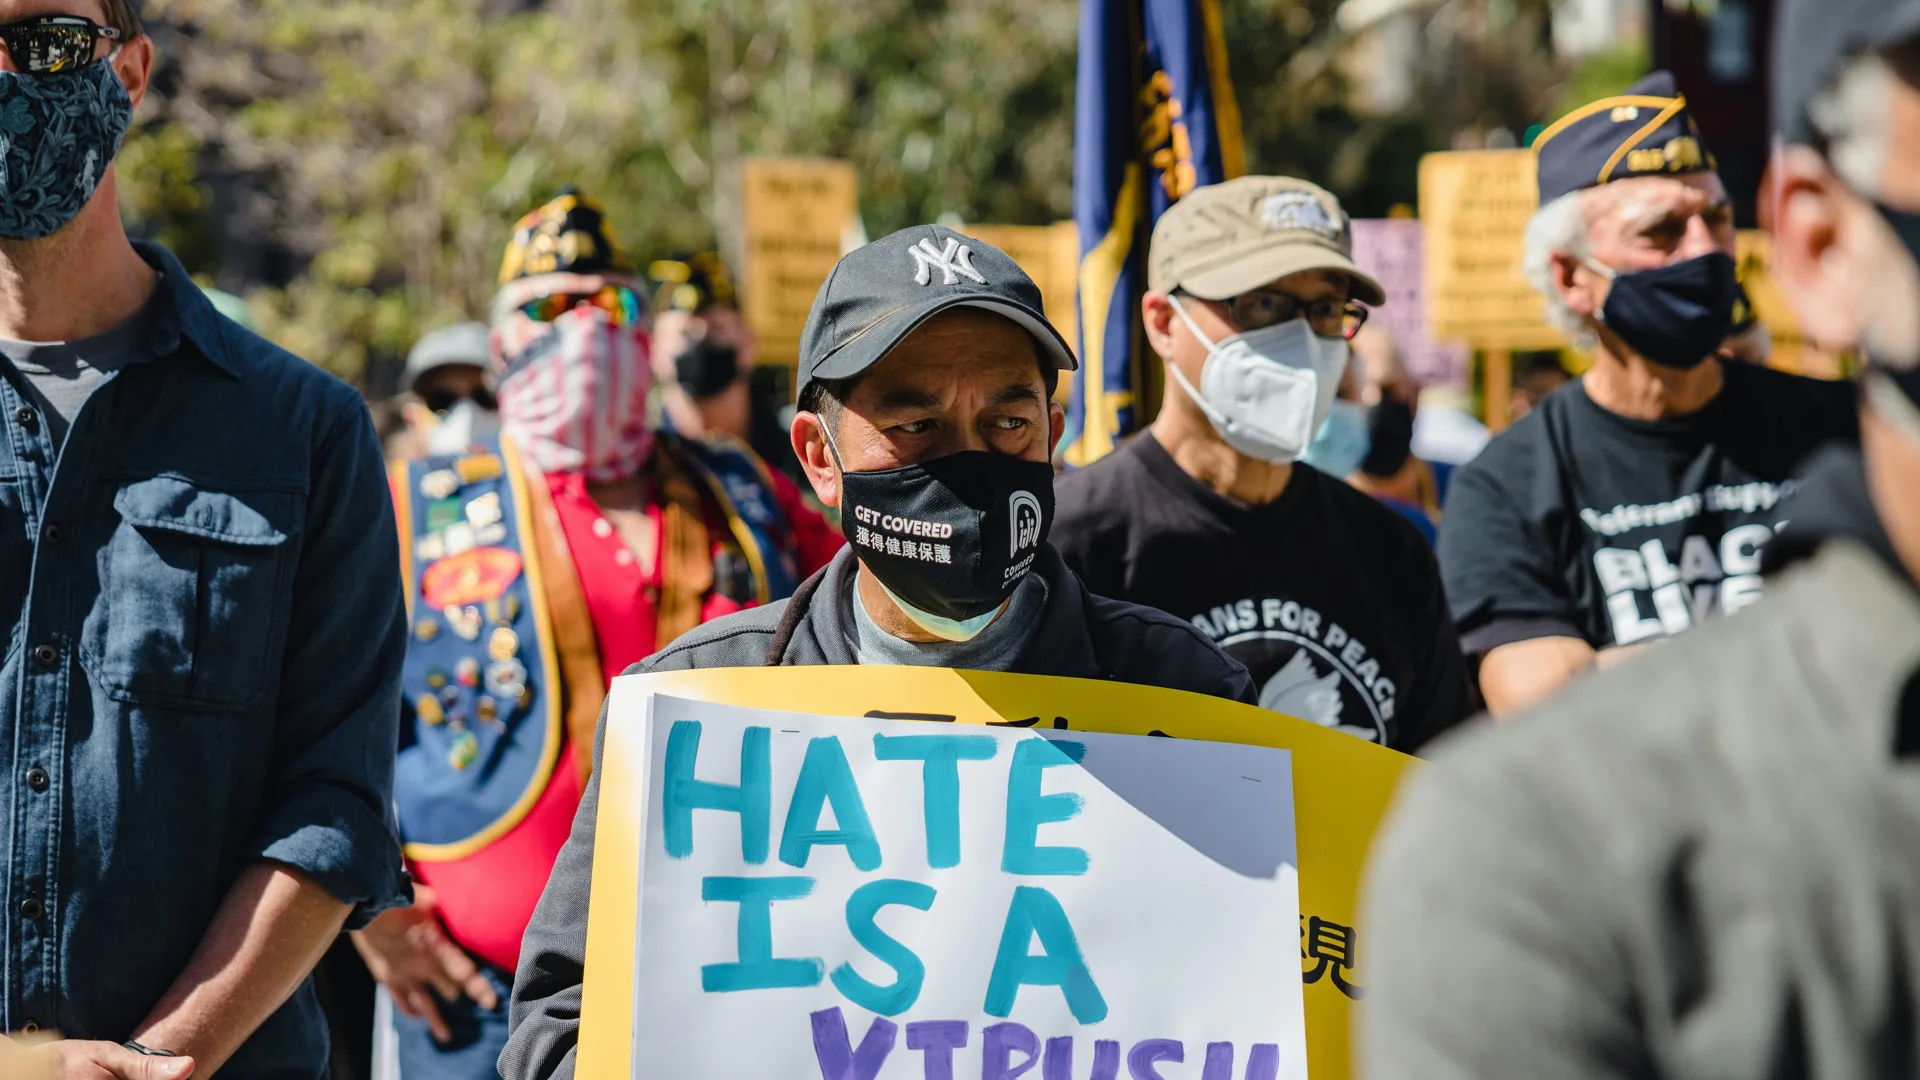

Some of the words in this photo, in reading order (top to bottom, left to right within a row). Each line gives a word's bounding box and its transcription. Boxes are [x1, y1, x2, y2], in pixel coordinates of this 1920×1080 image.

[908, 237, 986, 286] NY
[855, 505, 881, 526] GET
[882, 514, 953, 539] COVERED
[856, 525, 952, 564] 獲得健康保護
[1593, 520, 1790, 597] BLAC
[1261, 599, 1321, 639] FOR
[663, 720, 1091, 876] HATE
[701, 877, 938, 1017] IS
[983, 885, 1109, 1025] A
